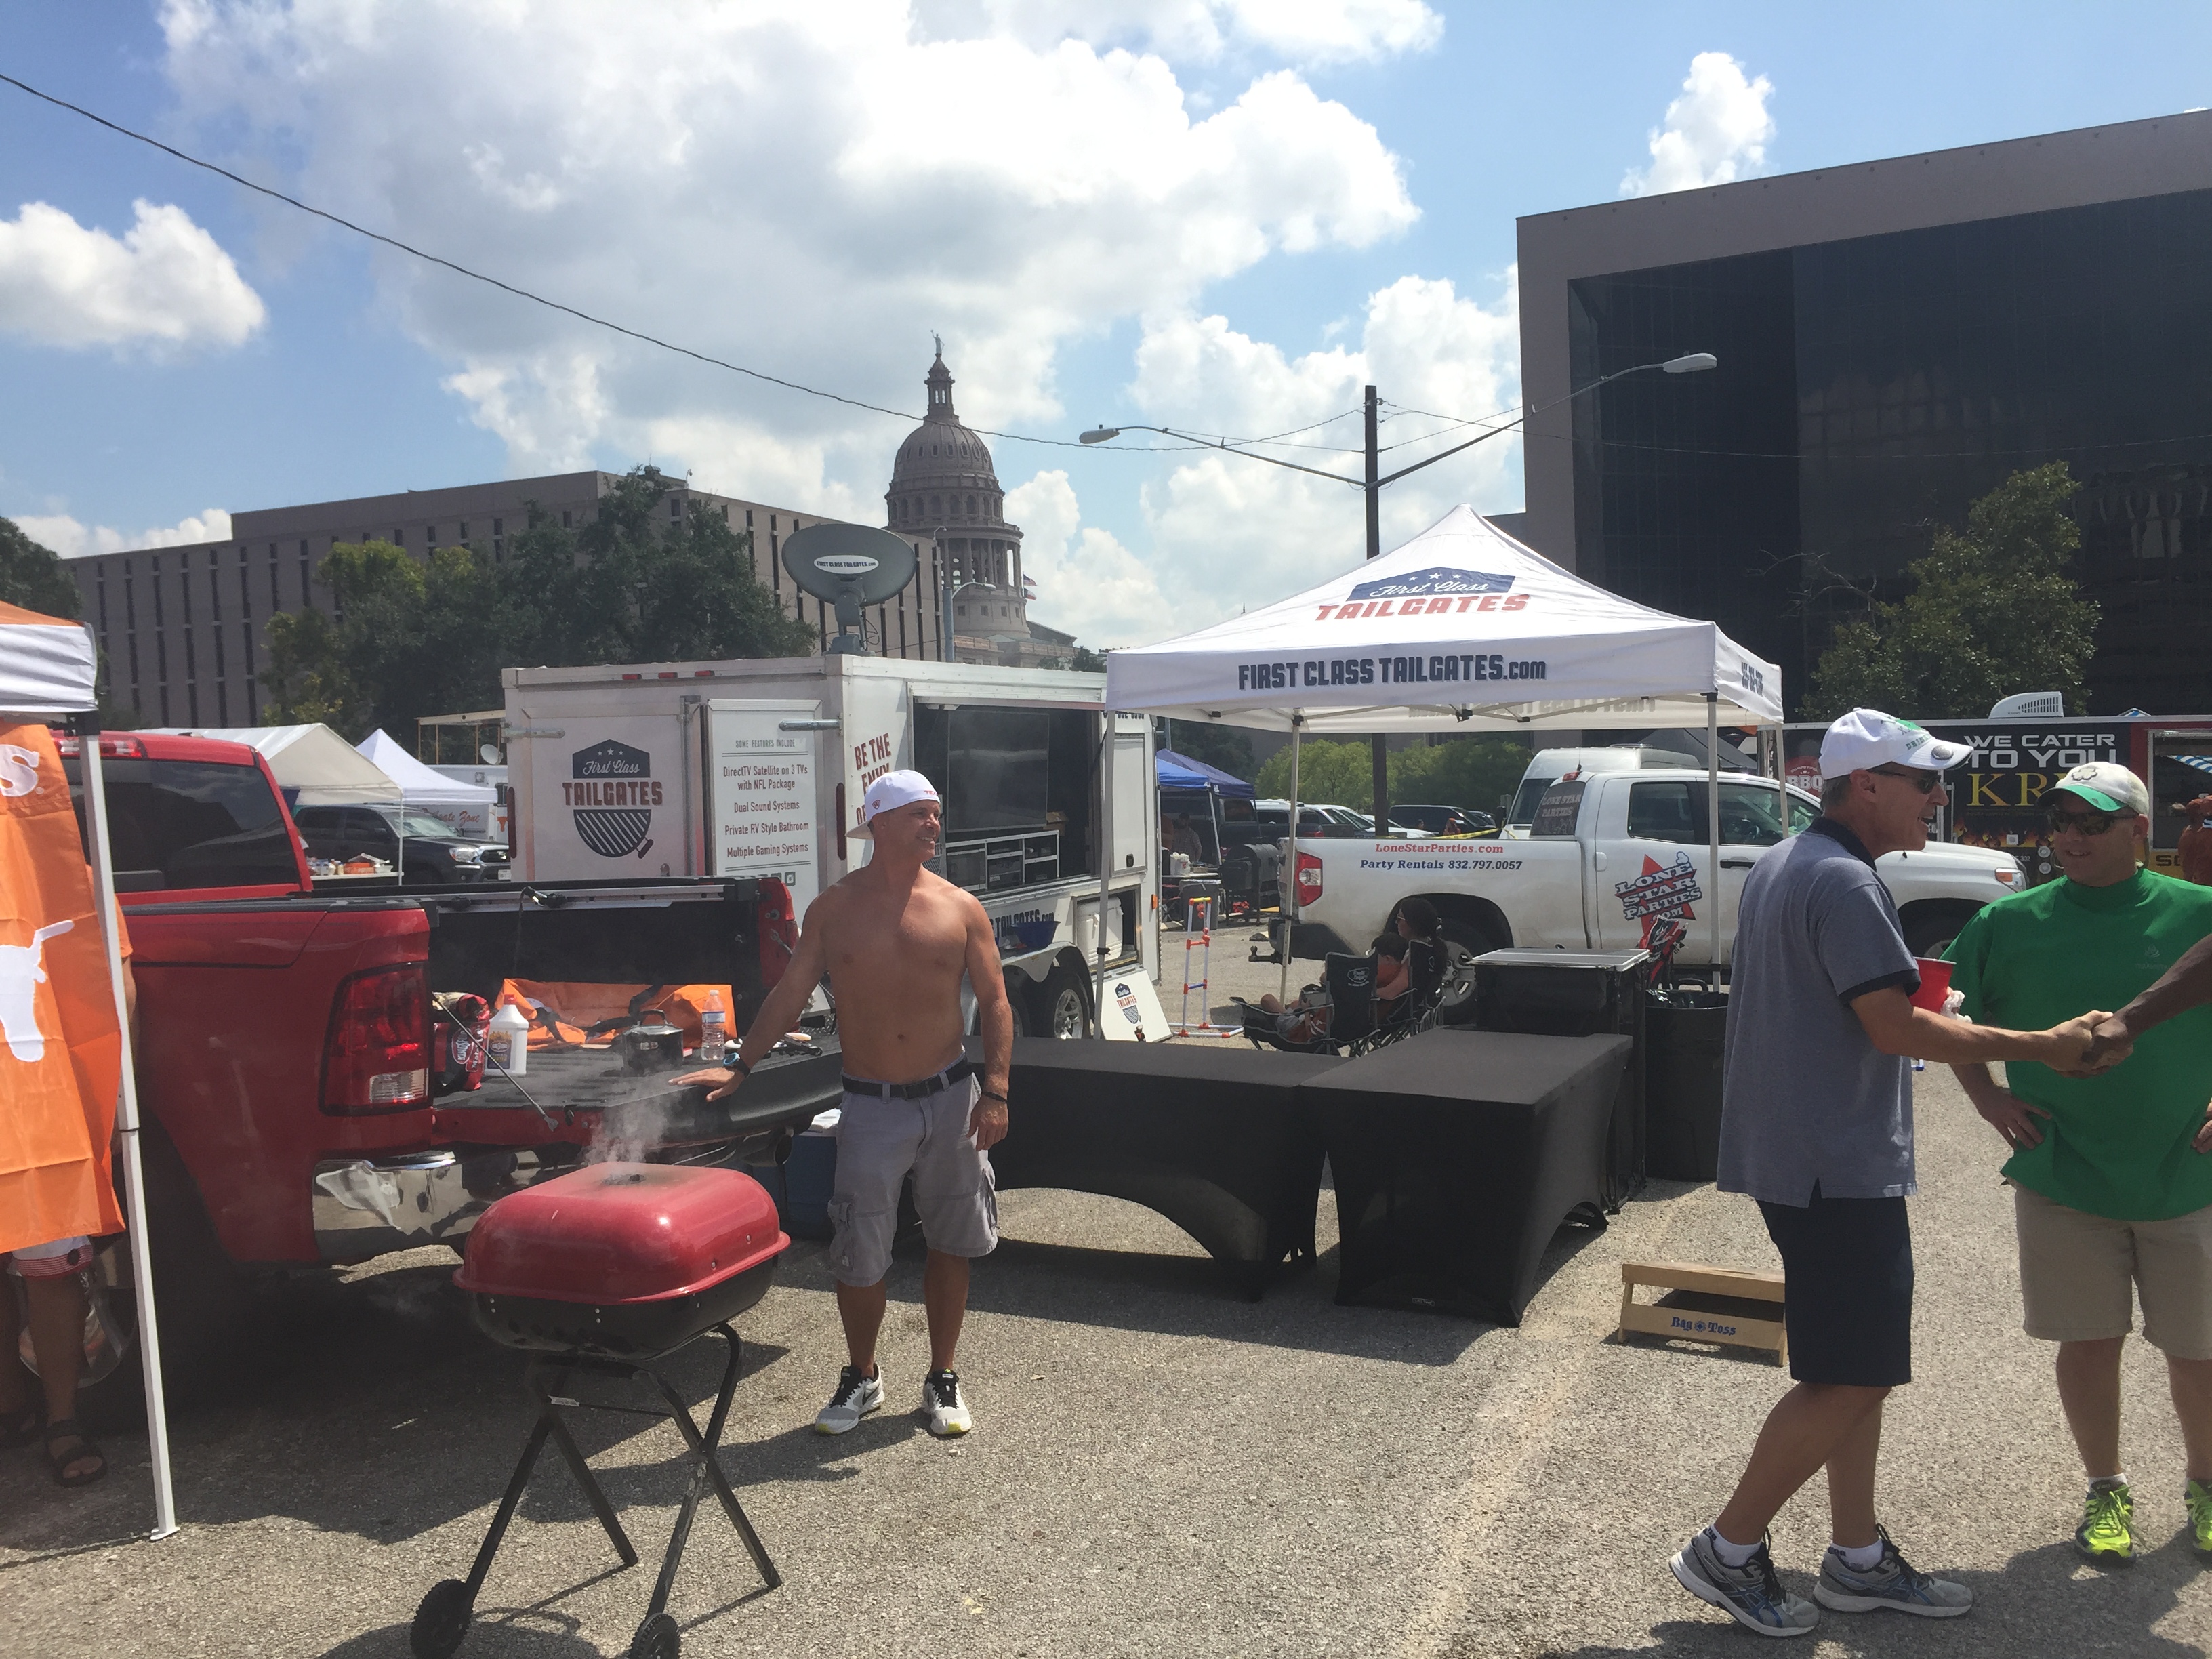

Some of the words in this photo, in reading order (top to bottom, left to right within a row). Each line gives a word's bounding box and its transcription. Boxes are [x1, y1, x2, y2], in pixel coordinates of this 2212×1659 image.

[1369, 583, 1429, 597] First
[1434, 581, 1489, 593] Class
[1315, 594, 1530, 621] TAILGATES
[1238, 662, 1299, 690] FIRST
[1304, 659, 1374, 687] CLASS
[1378, 654, 1547, 684] TAILGATES.com
[736, 740, 749, 748] SOME
[1964, 735, 2012, 747] WE
[2022, 734, 2115, 746] CATER
[854, 743, 868, 770] BE
[869, 733, 891, 762] THE
[1971, 749, 2018, 768] TO
[2028, 748, 2116, 768] YOU
[583, 760, 610, 775] First
[612, 760, 640, 773] Class
[723, 766, 752, 777] DirectTV
[754, 764, 779, 776] Satellite
[792, 764, 795, 774] 3
[797, 764, 808, 774] TVs
[737, 780, 752, 790] with
[754, 779, 766, 790] NFL
[769, 779, 795, 791] Package
[1786, 775, 1823, 792] BBQ
[562, 781, 663, 806] TAILGATES
[734, 802, 749, 813] Dual
[750, 801, 771, 812] Sound
[773, 800, 800, 813] Systems
[725, 824, 748, 835] Private
[750, 823, 759, 834] RV
[761, 822, 777, 835] Style
[779, 821, 808, 832] Bathroom
[727, 846, 754, 859] Multiple
[756, 844, 779, 856] Gaming
[781, 843, 808, 855] Systems
[1375, 844, 1504, 853] LoneStarParties.com
[1360, 859, 1394, 870] Party
[1397, 860, 1444, 869] Rentals
[1448, 860, 1523, 870] 832.797.0057
[1616, 863, 1693, 893] LONE
[1623, 878, 1696, 906] STAR
[1624, 887, 1702, 920] PARTIES
[1671, 1317, 1692, 1331] Bag
[1708, 1322, 1736, 1336] Toss
